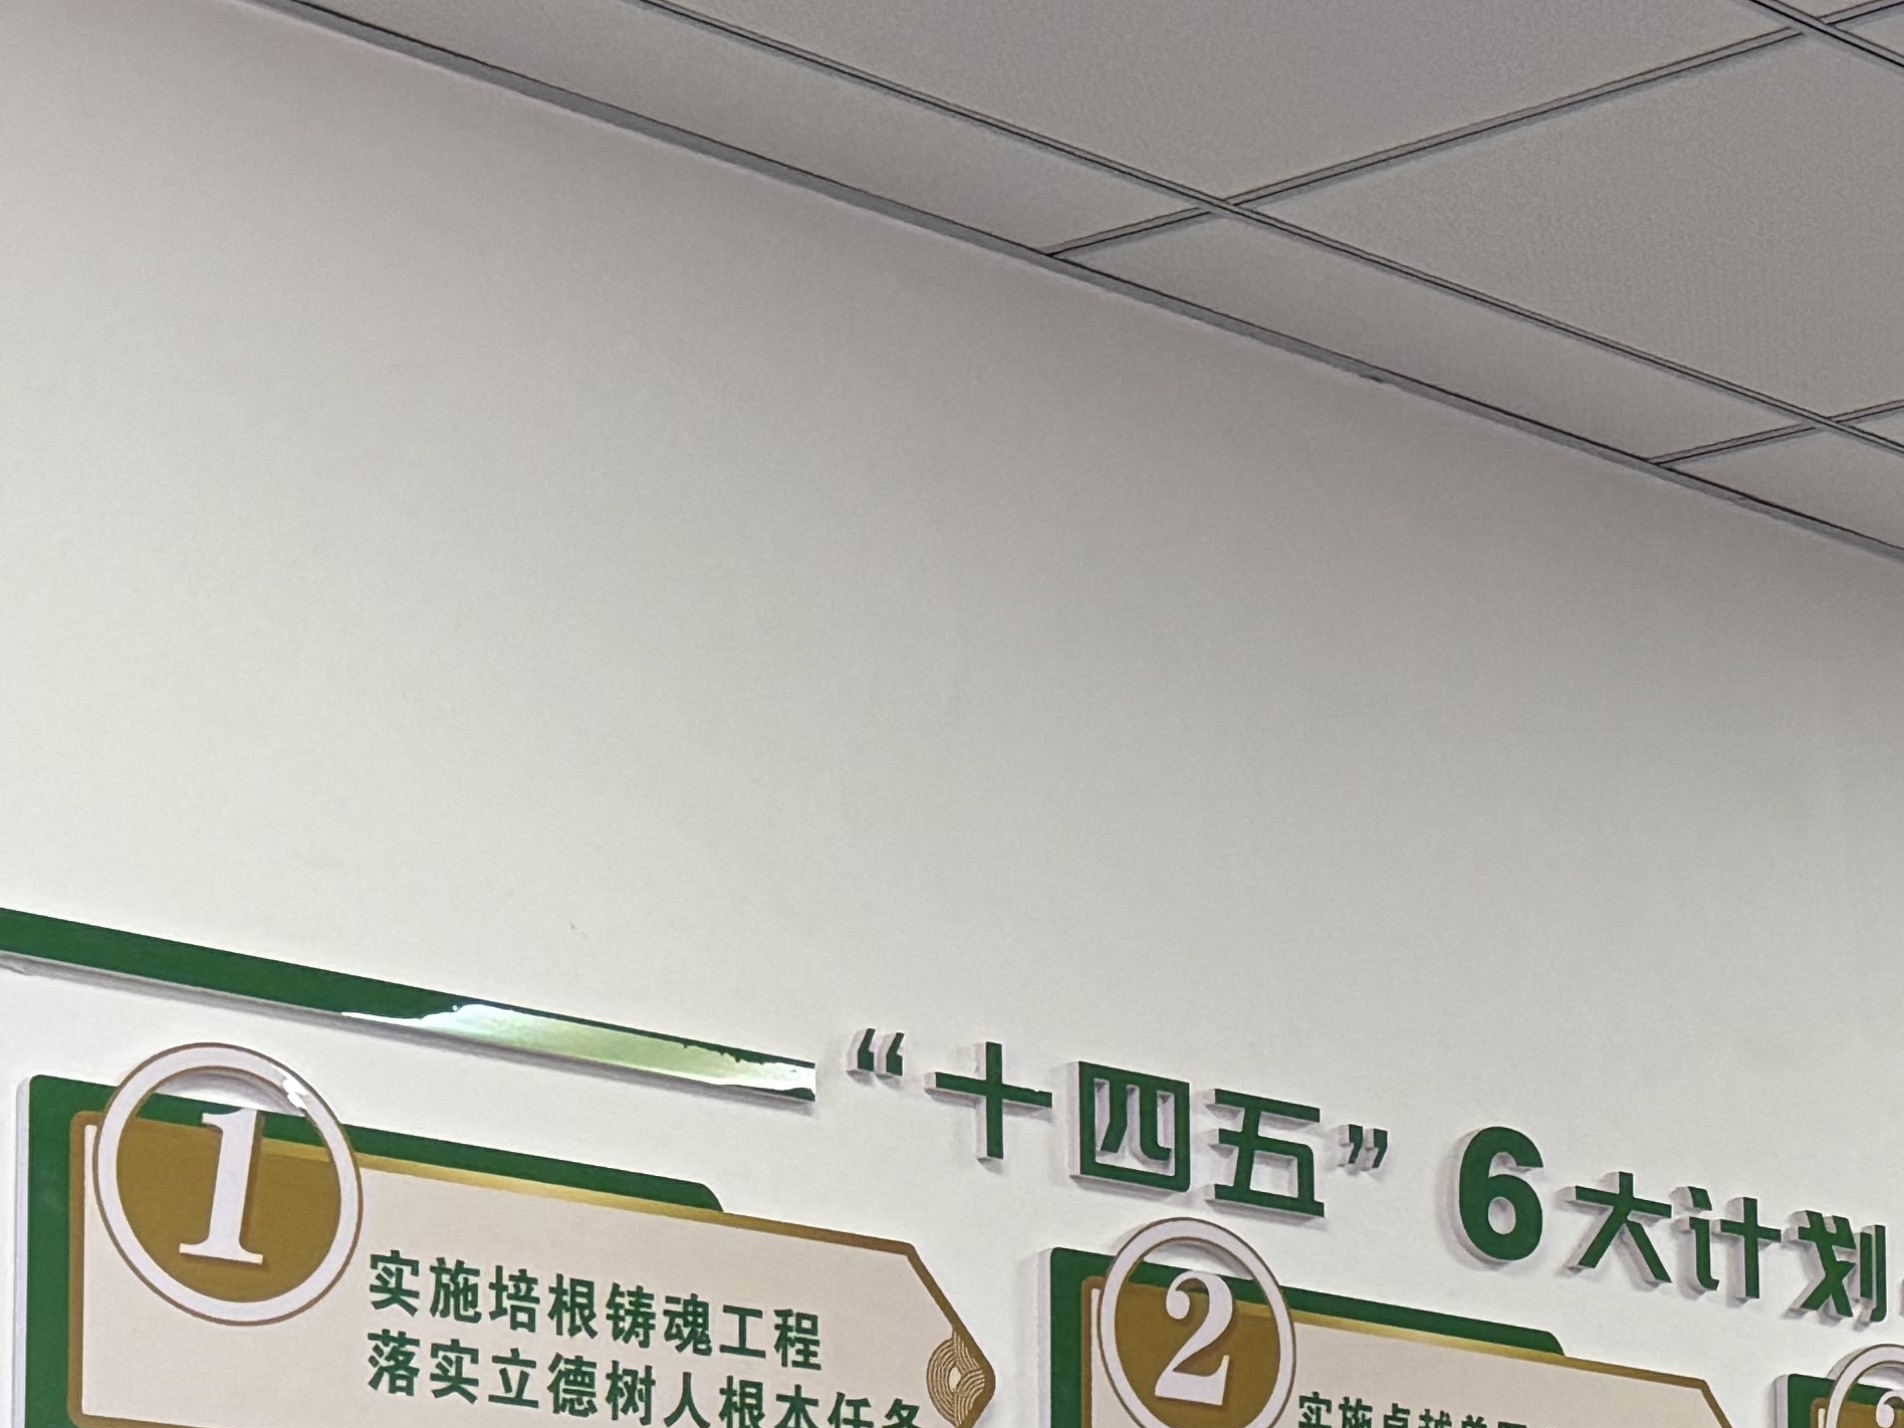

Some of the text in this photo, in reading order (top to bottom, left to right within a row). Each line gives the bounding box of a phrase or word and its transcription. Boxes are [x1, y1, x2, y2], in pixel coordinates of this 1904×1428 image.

[179, 1107, 263, 1266] 1
[369, 1250, 823, 1372] 实施培根铸魂工程
[1154, 1272, 1235, 1406] 2
